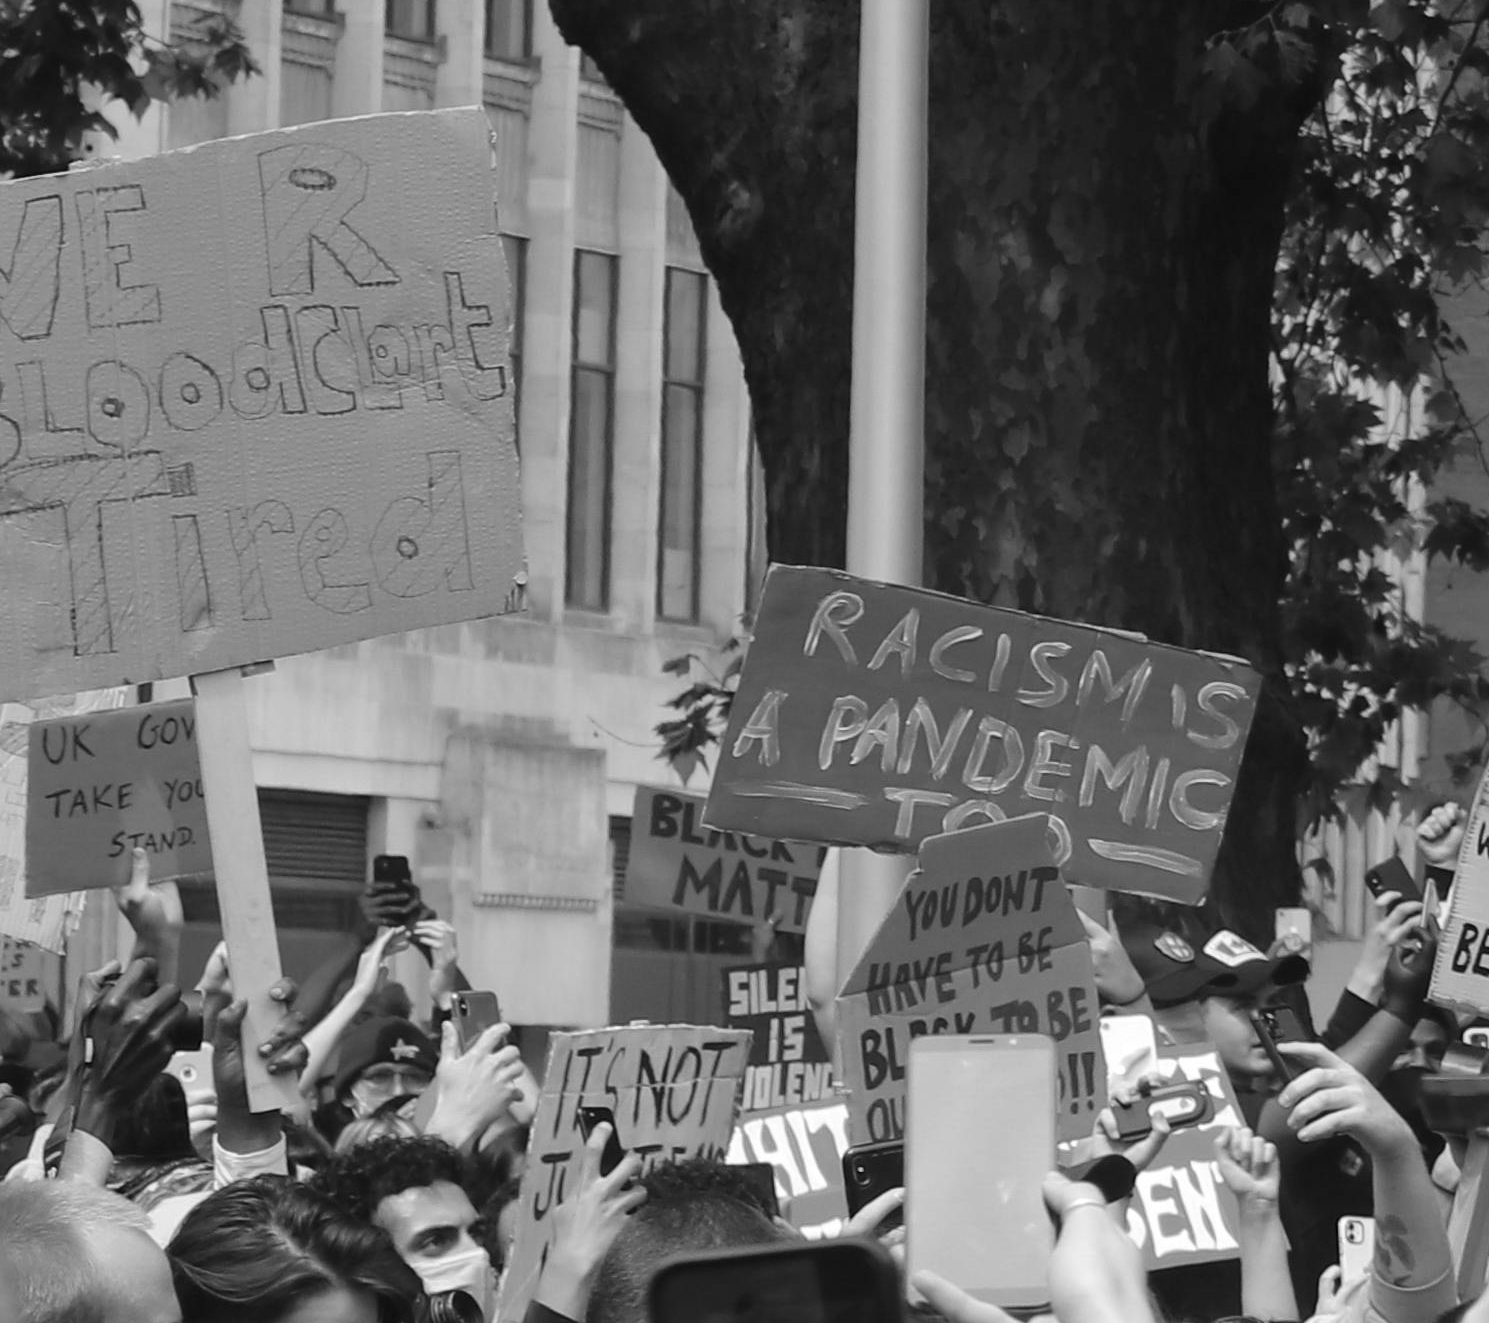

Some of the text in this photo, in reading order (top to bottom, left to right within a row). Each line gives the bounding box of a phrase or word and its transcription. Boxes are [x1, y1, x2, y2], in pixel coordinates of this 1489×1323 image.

[257, 142, 401, 298] R
[803, 591, 1252, 749] RACISM IS
[41, 724, 96, 765] UK
[732, 689, 1233, 831] A PANDEMIC
[45, 782, 132, 818] TAKE
[905, 882, 959, 941] YOU
[866, 926, 1053, 1017] HAVE TO BE
[768, 1016, 805, 1062] IS
[1047, 986, 1092, 1042] BE
[634, 1041, 738, 1128] NOT
